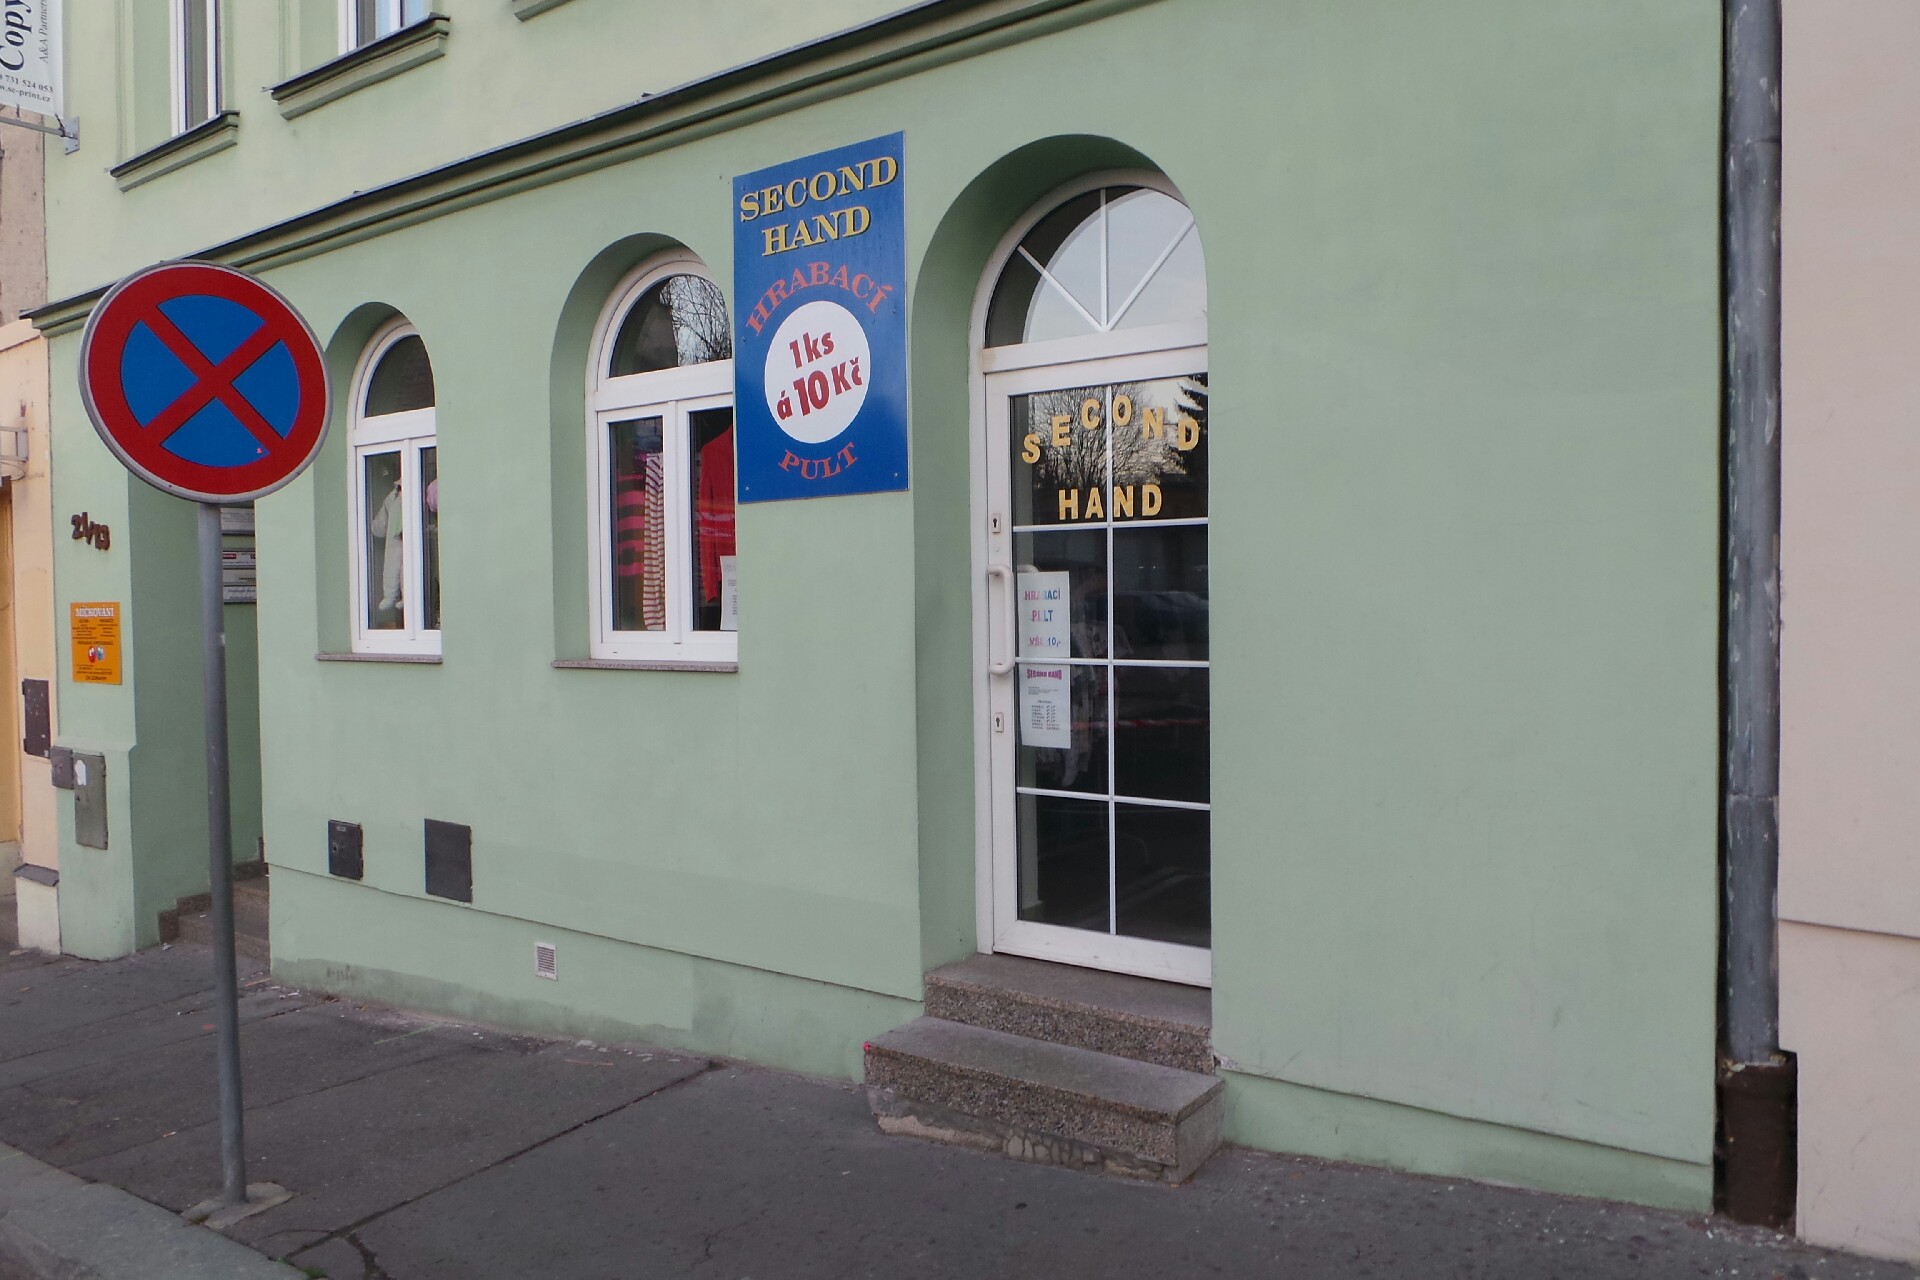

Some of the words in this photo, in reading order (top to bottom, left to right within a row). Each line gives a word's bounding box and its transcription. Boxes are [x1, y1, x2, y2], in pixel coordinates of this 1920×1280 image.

[38, 37, 48, 63] A&A
[5, 74, 19, 84] 731
[22, 79, 36, 89] 524
[740, 156, 898, 222] SECOND
[762, 205, 872, 256] HAND
[746, 261, 893, 336] HRABACÍ
[1021, 394, 1200, 464] SECOND
[778, 441, 858, 480] PULT
[1058, 484, 1163, 521] HAND
